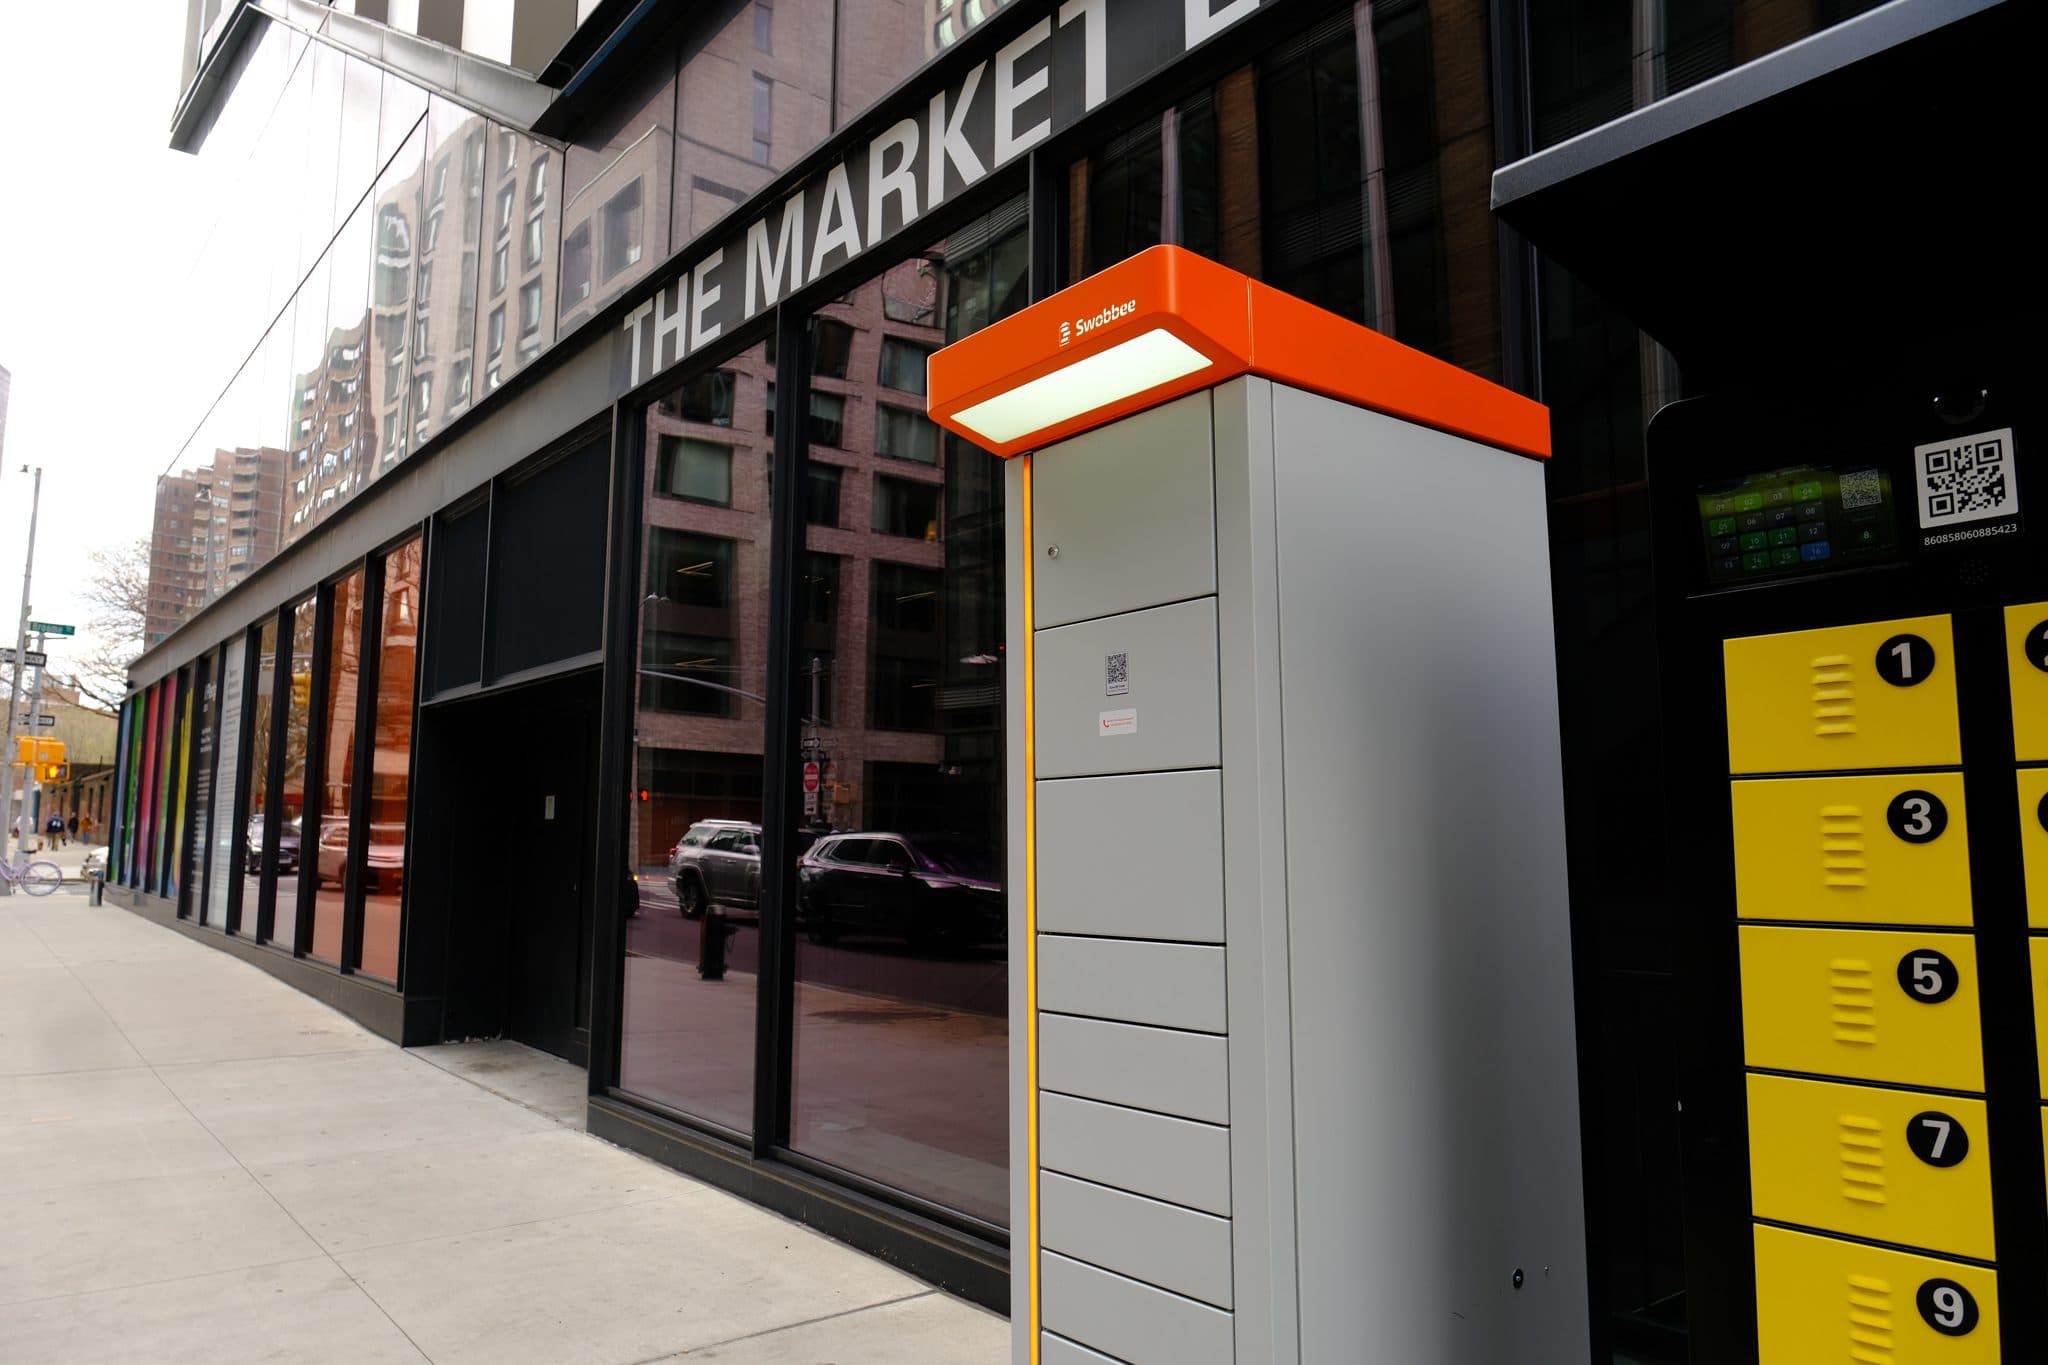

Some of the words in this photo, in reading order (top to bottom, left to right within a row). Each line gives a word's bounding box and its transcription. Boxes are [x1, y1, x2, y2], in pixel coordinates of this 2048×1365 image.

[624, 248, 723, 387] THE
[744, 0, 1107, 320] MARKET
[1075, 299, 1136, 337] Swobbee
[1924, 523, 2018, 546] 860858060885423
[1891, 642, 1913, 679] 1
[1903, 798, 1933, 836] 3
[1913, 957, 1943, 996] 5
[1922, 1119, 1951, 1158] 7
[1932, 1286, 1965, 1328] 9
